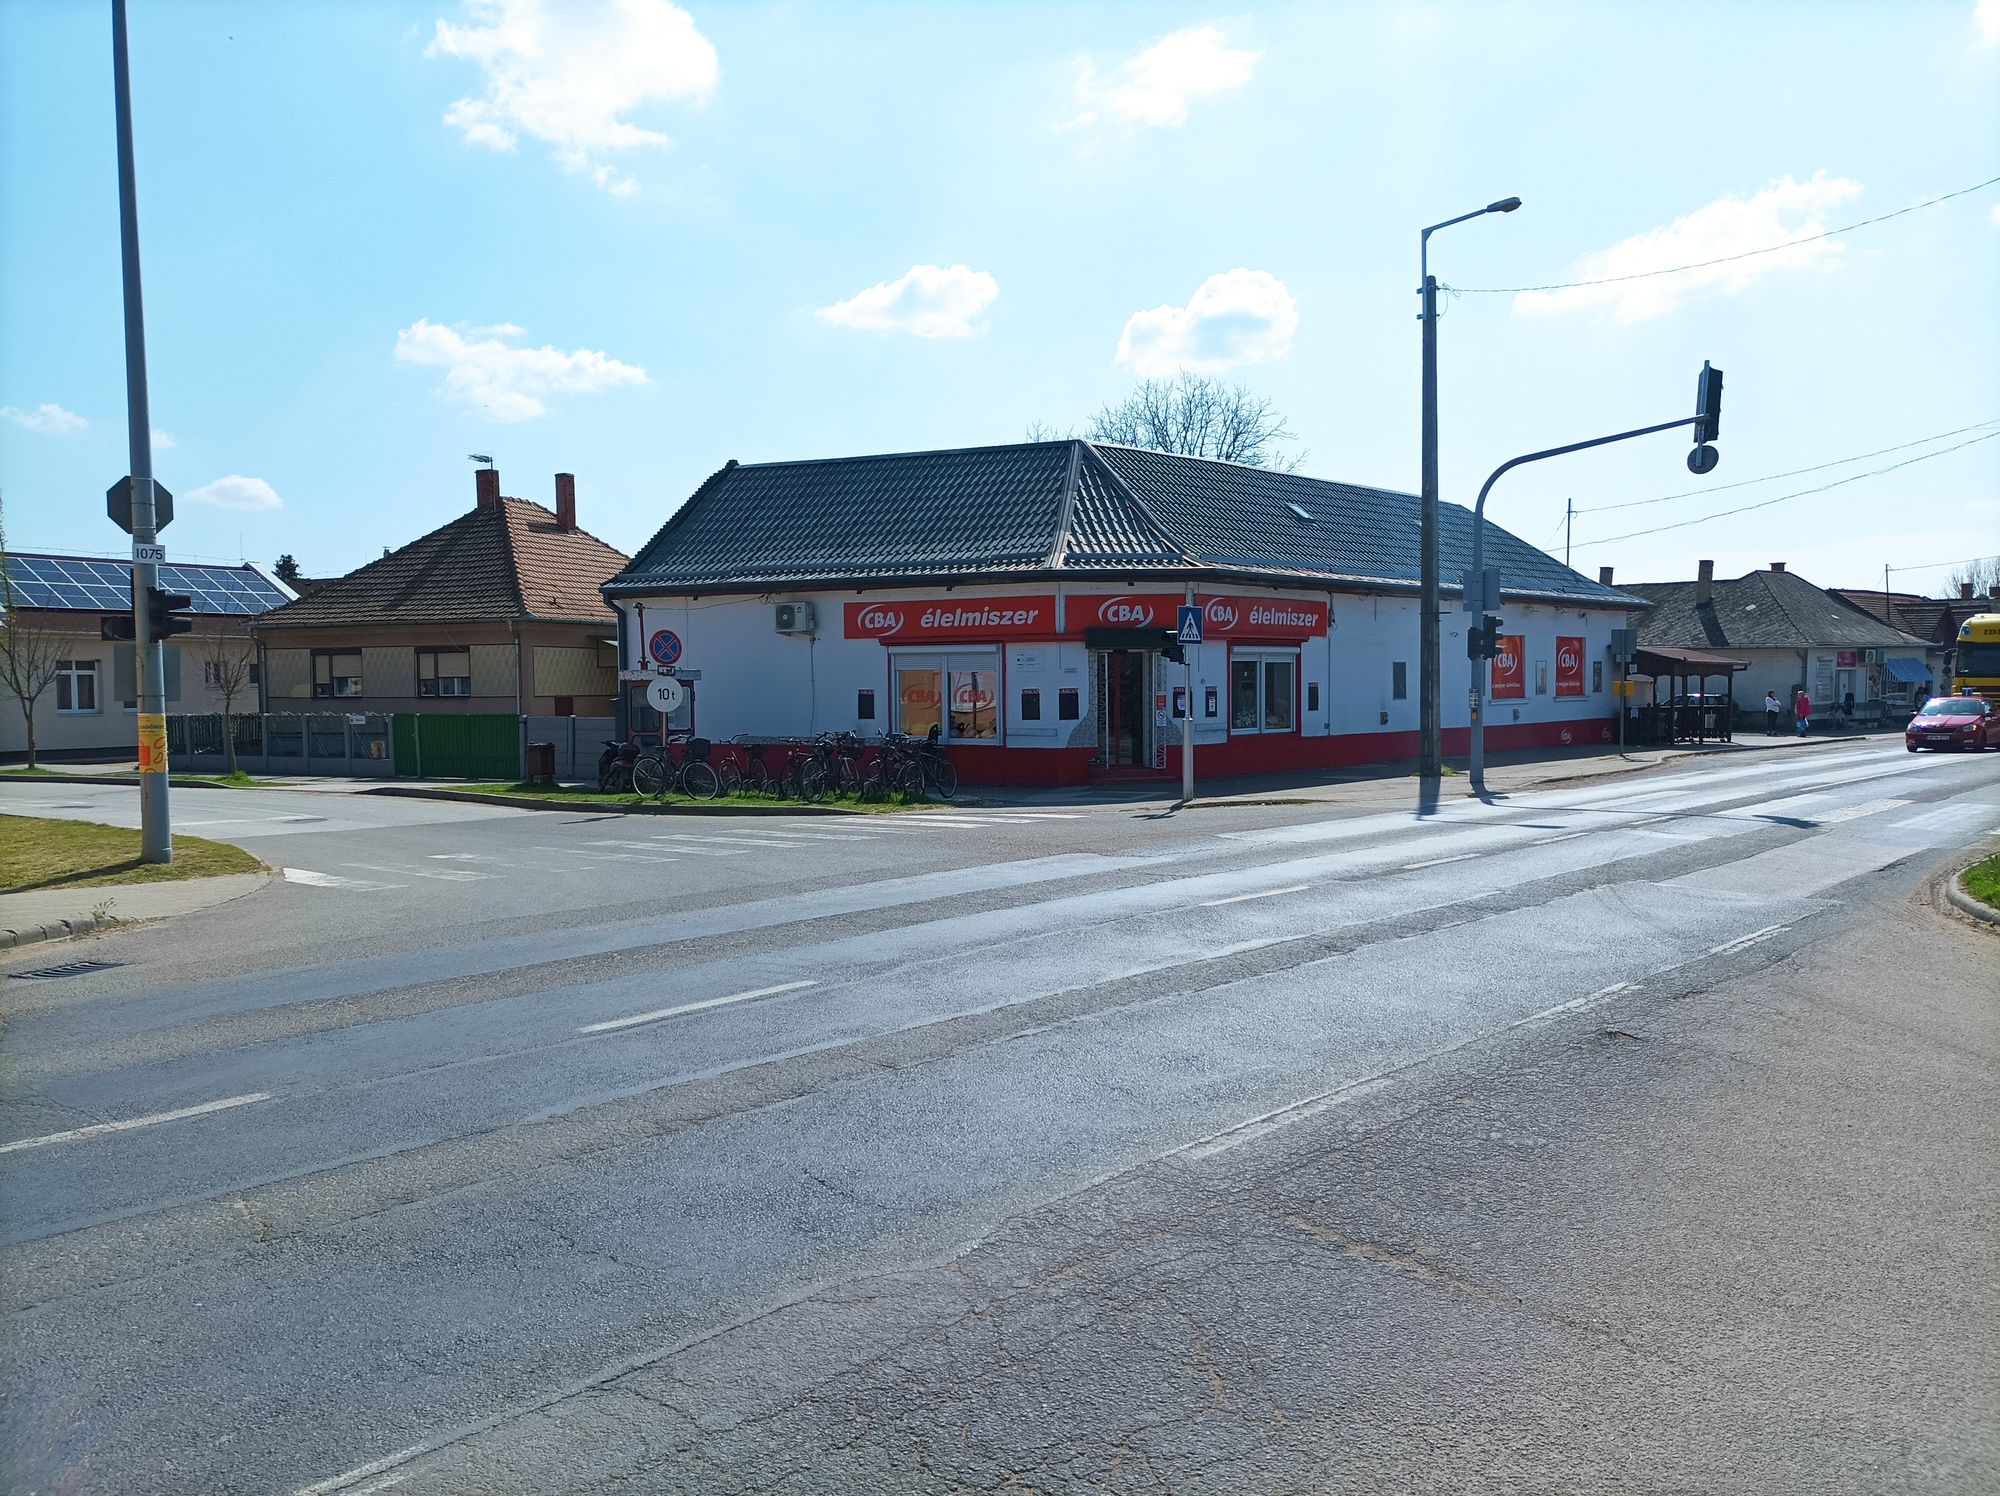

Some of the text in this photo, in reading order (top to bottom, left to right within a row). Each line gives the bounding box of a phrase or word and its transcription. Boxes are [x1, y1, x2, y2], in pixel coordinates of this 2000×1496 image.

[136, 547, 163, 560] 1075
[864, 605, 1039, 630] CBA élelmiszer
[1107, 604, 1145, 623] CBA
[1210, 605, 1320, 627] CBA élelmiszer
[1497, 653, 1514, 668] CBA
[1561, 653, 1576, 668] CBA
[657, 688, 676, 701] 10 t
[907, 688, 936, 703] CBA
[959, 688, 988, 703] CBA
